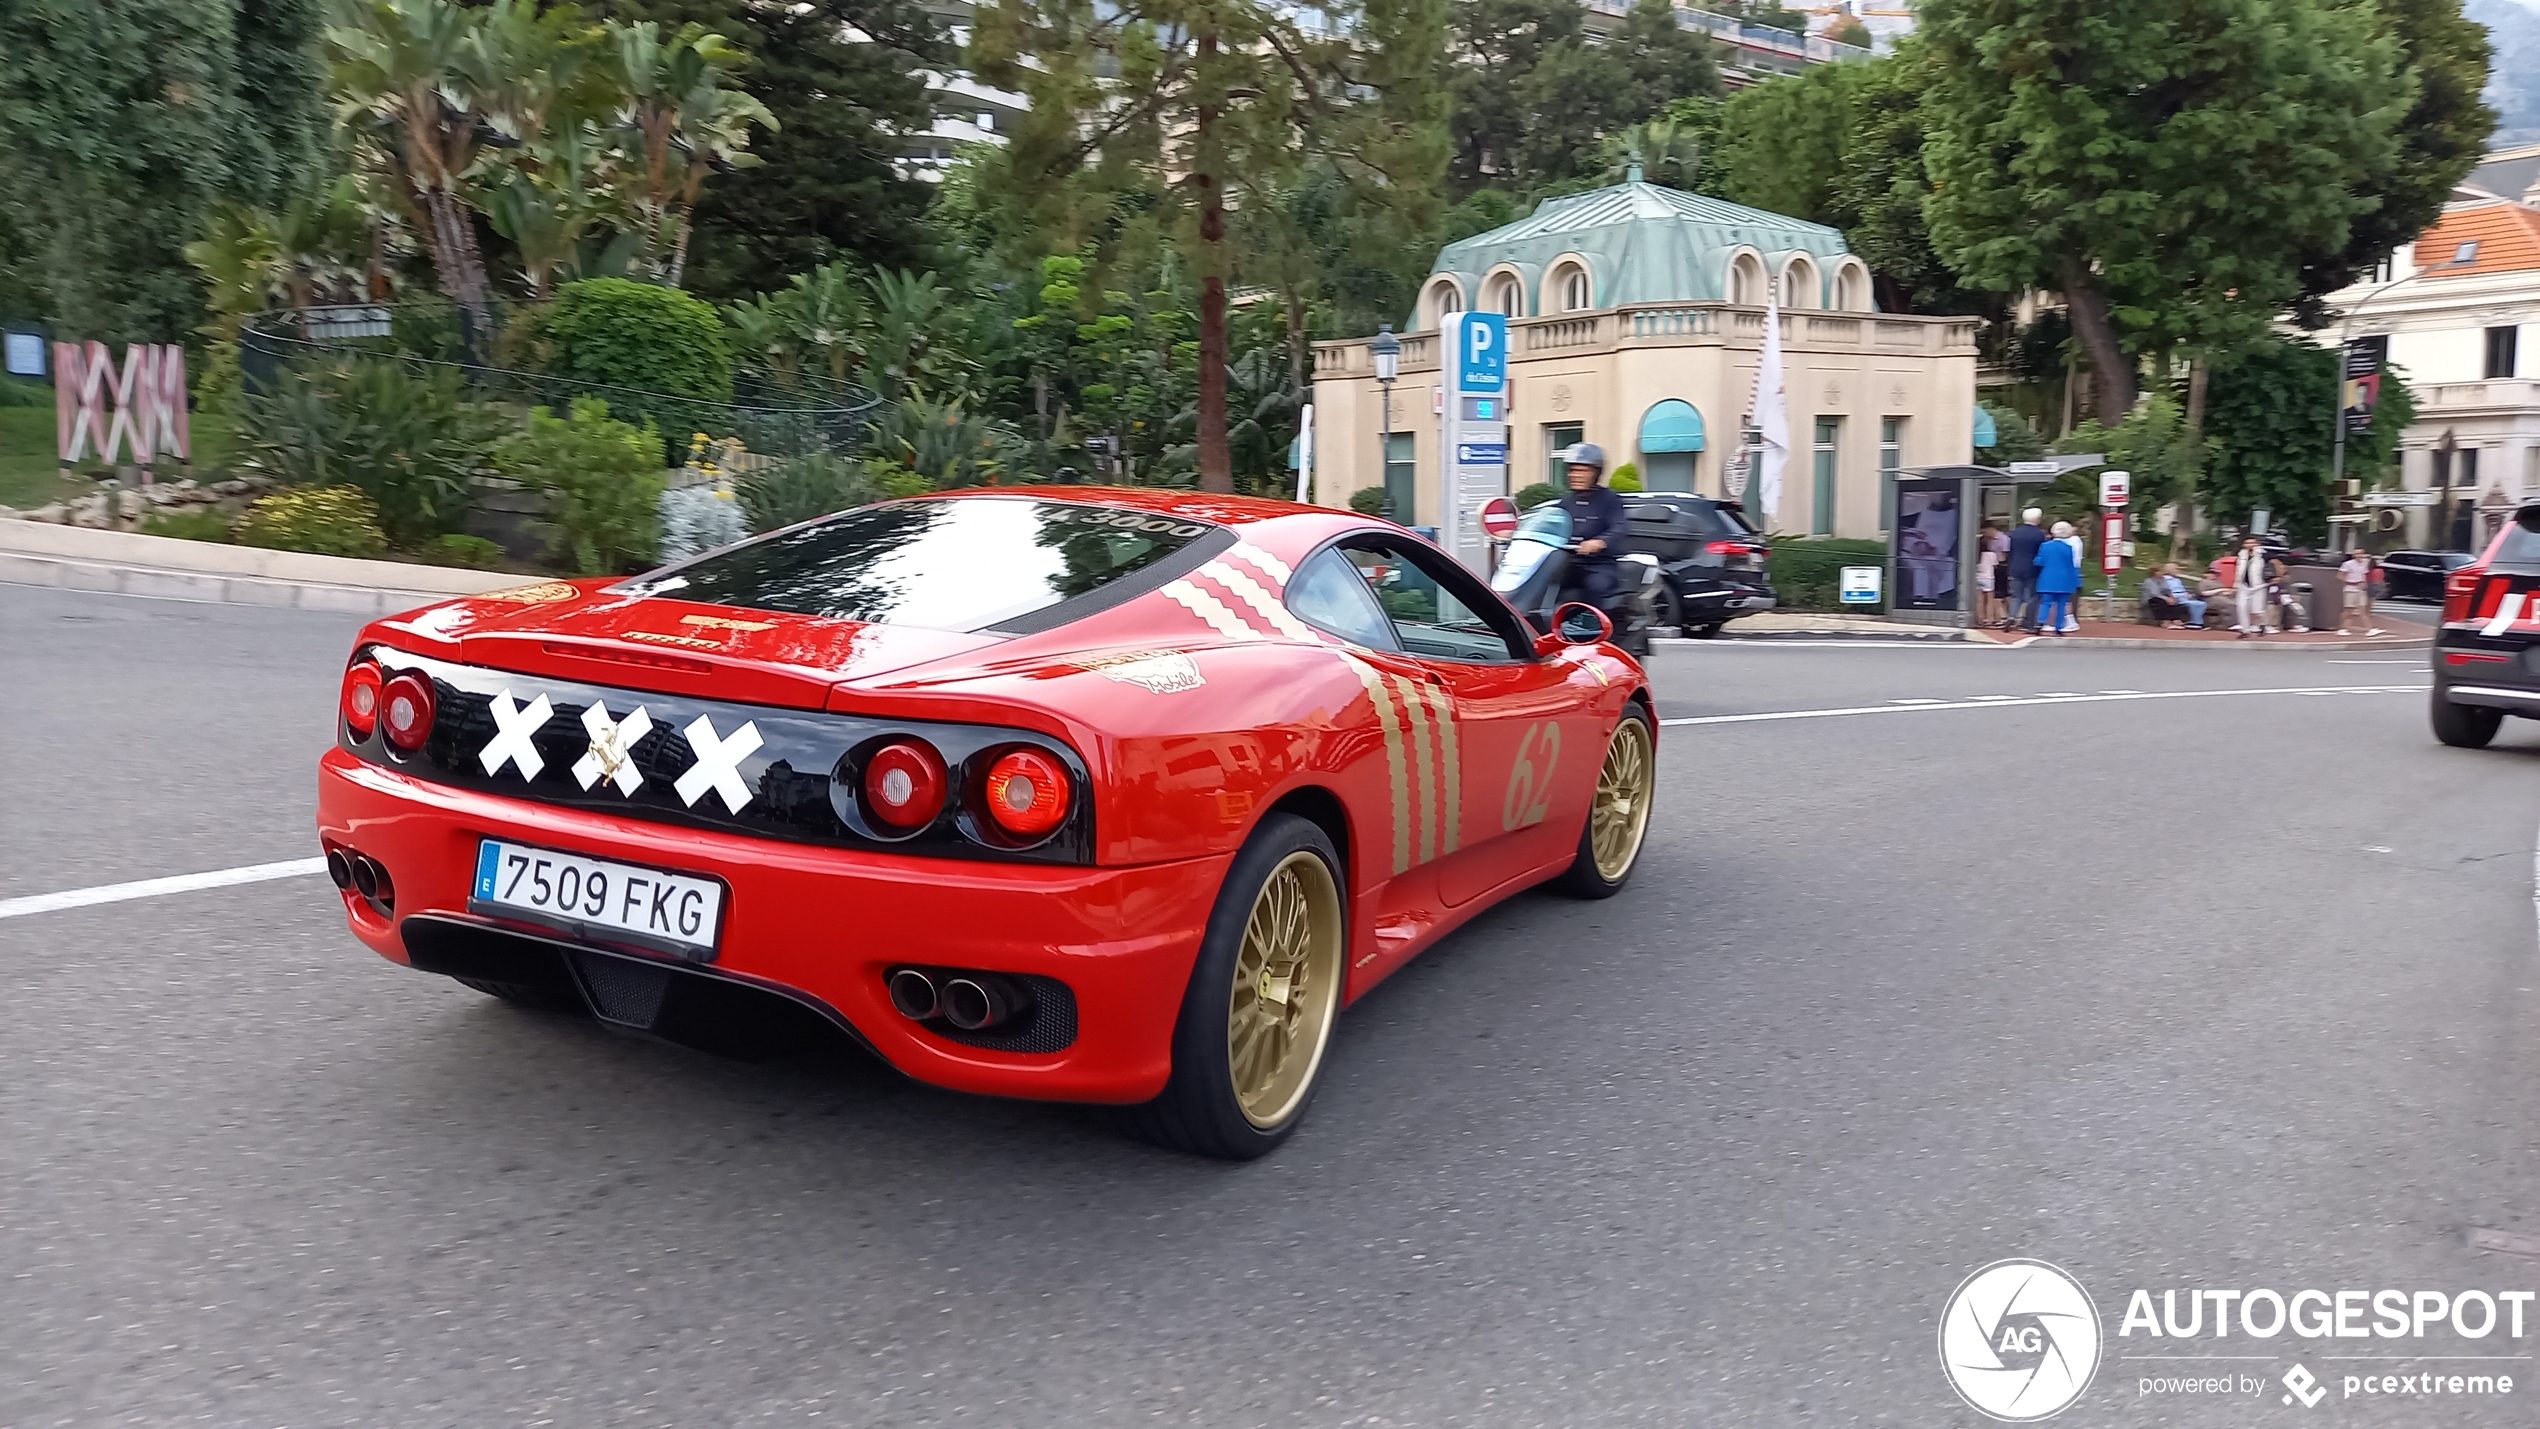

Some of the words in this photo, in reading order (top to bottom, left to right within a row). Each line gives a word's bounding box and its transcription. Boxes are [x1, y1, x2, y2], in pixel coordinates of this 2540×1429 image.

[1470, 321, 1493, 364] P
[1079, 512, 1208, 537] 3000
[1502, 720, 1561, 832] 62
[482, 877, 491, 893] E
[503, 853, 608, 917] 7509
[622, 876, 703, 937] FKG
